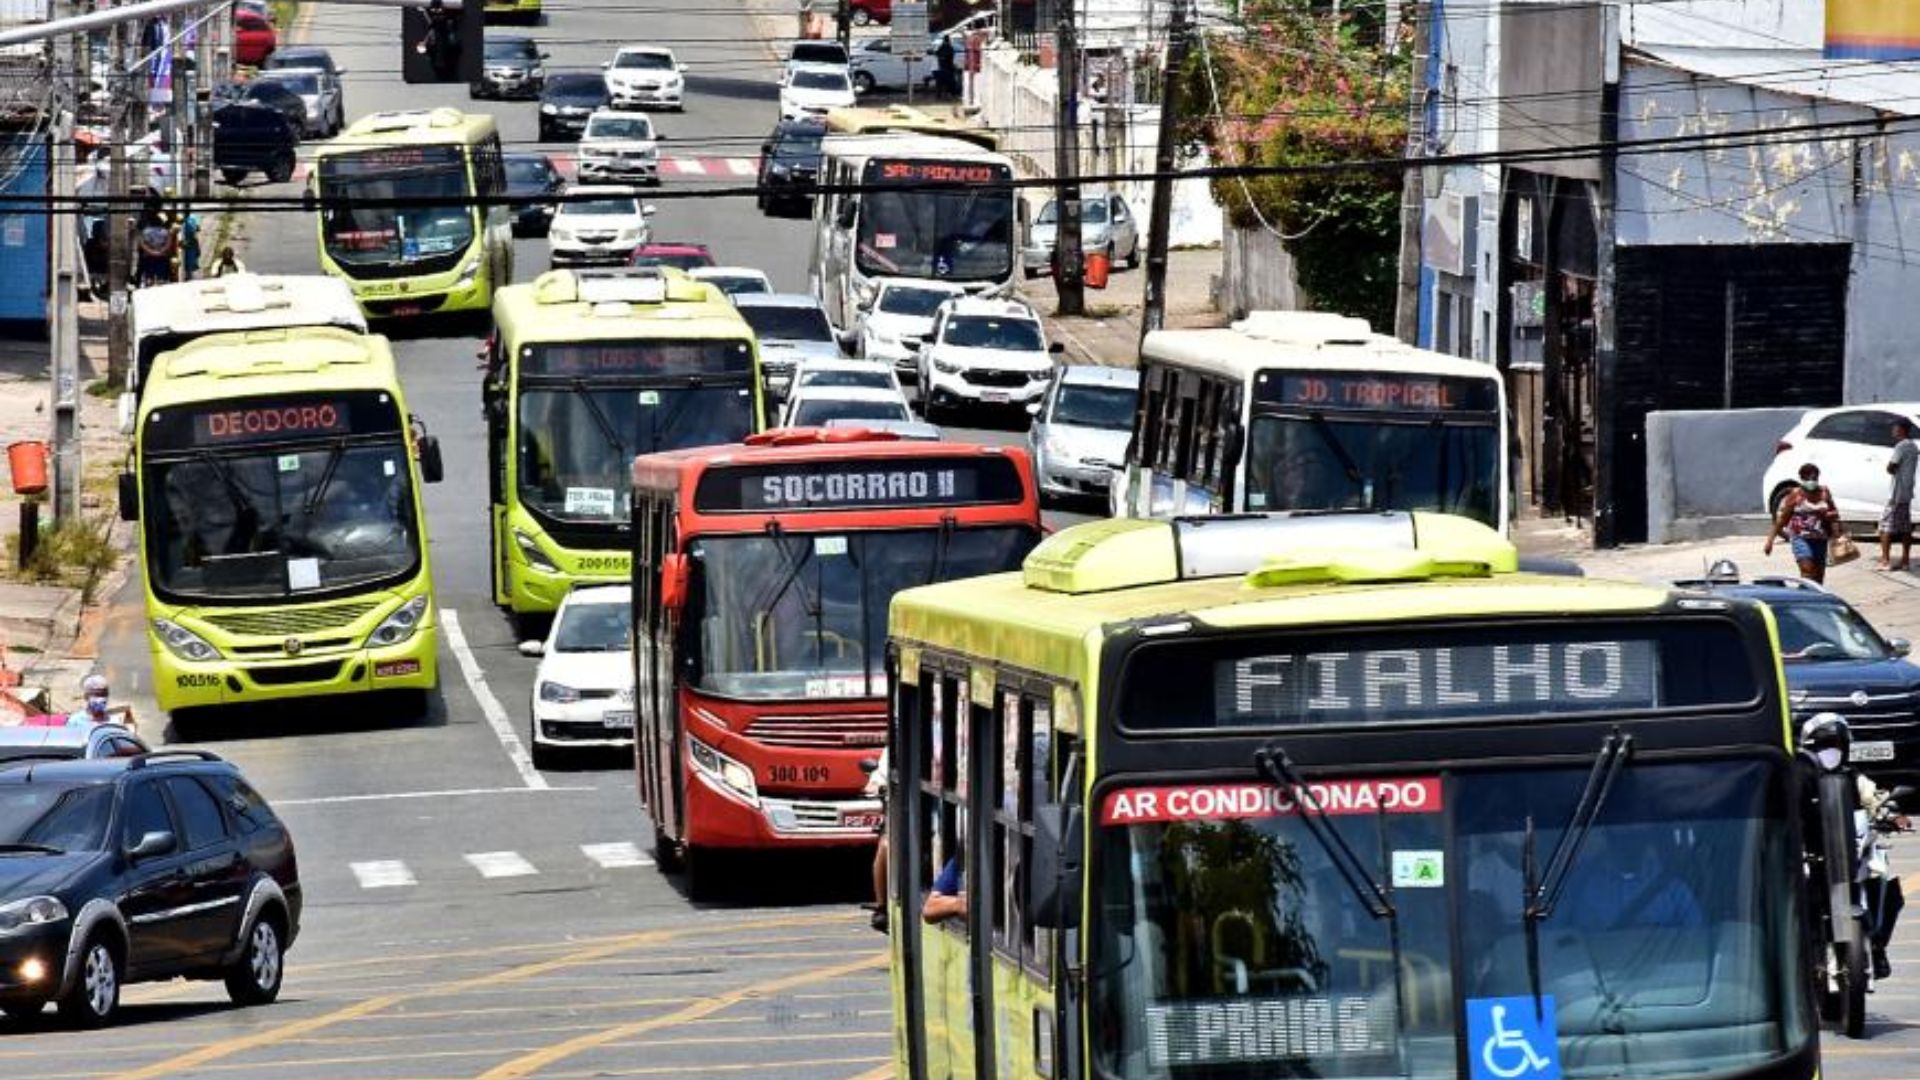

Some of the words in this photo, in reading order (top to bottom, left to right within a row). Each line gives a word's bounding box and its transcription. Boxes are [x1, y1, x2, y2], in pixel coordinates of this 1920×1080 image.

[1342, 380, 1456, 408] TROPICAL
[208, 404, 337, 436] DEODORO
[762, 471, 928, 504] SOCORRAO
[1235, 641, 1622, 713] FIALHO
[1111, 793, 1158, 820] AR
[1166, 782, 1427, 817] CONDICIONADO
